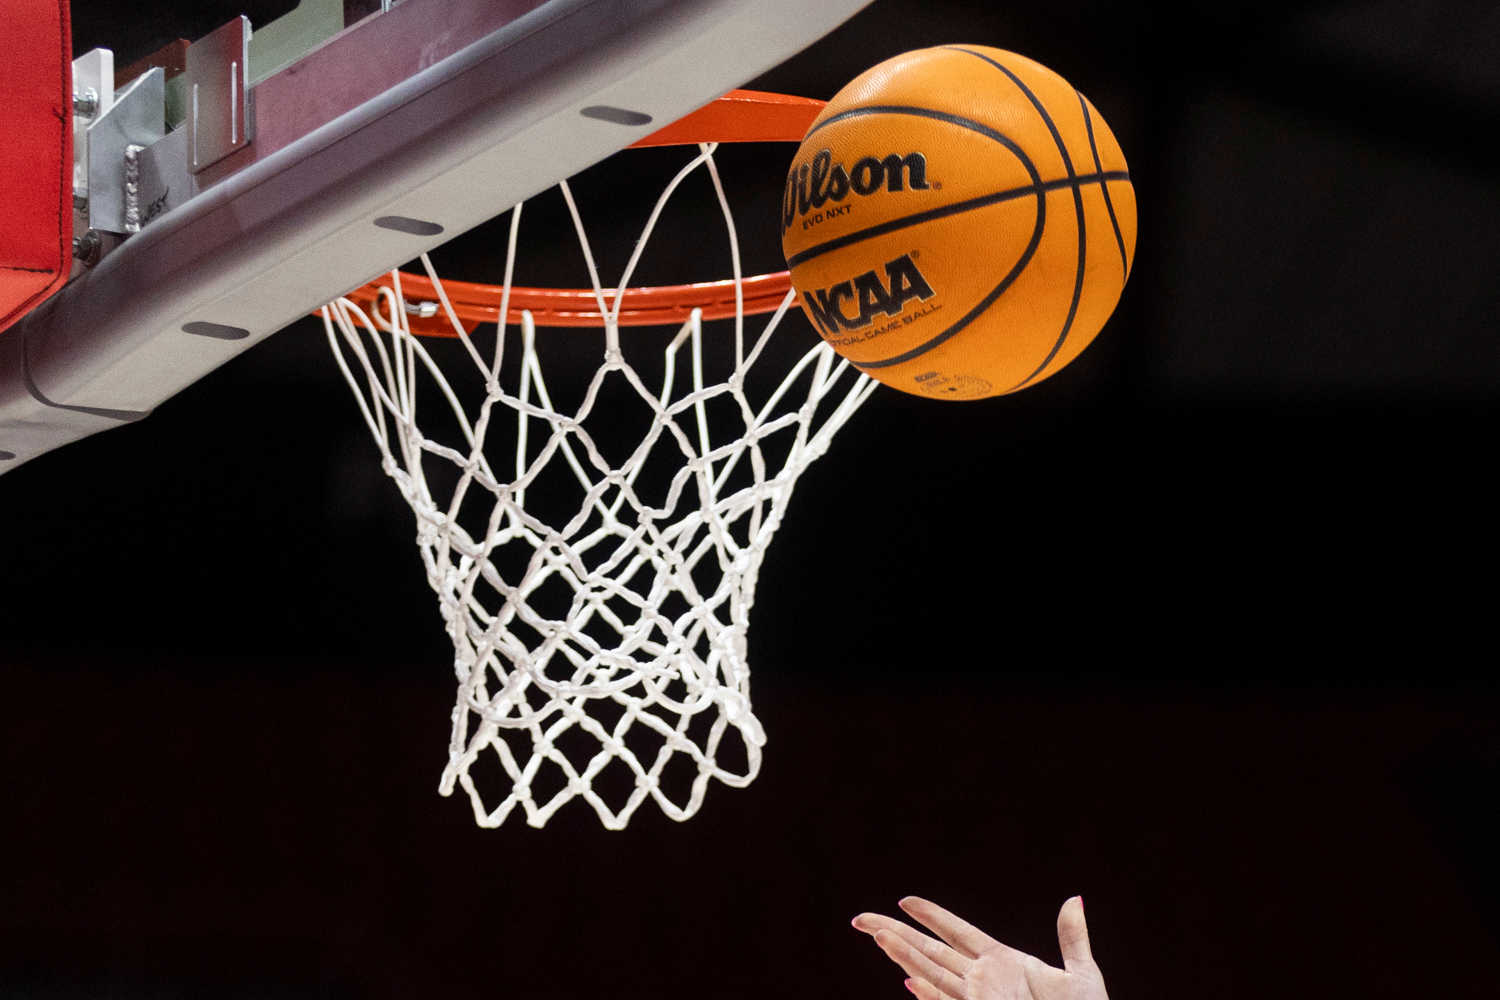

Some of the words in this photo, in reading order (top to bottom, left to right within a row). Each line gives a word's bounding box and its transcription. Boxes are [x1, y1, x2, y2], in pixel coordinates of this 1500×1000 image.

[803, 214, 823, 231] EVO
[826, 204, 852, 219] NXT
[803, 253, 936, 335] NCAA
[865, 320, 901, 339] GAME
[902, 303, 942, 325] BALL
